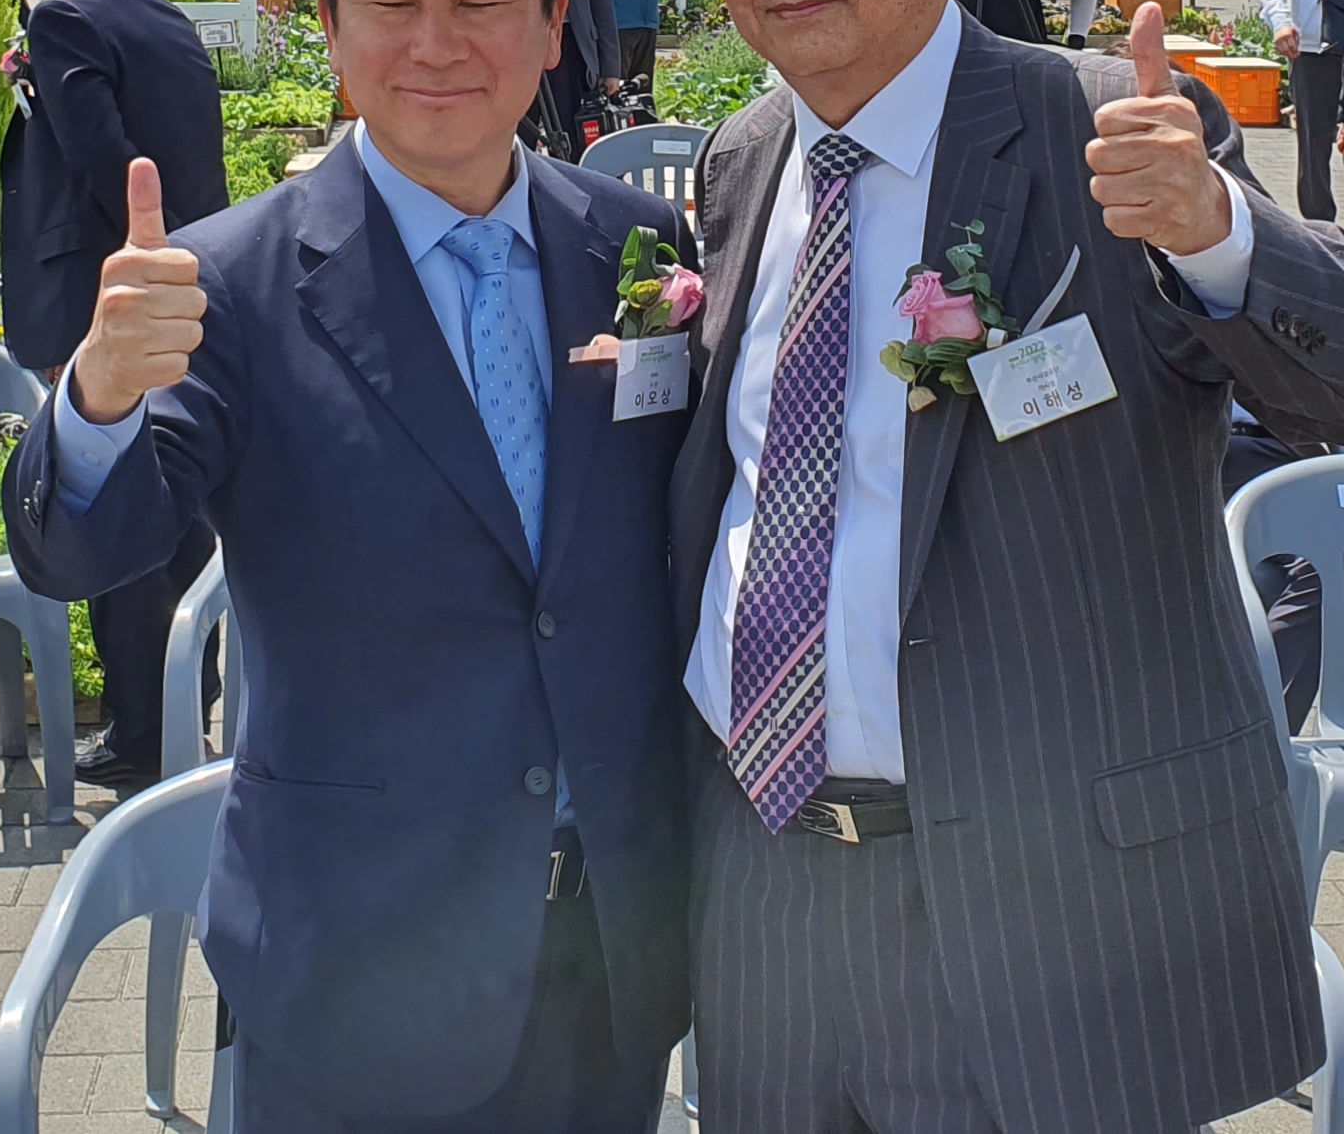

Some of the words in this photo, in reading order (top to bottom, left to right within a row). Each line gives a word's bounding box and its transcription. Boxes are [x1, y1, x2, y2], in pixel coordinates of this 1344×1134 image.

[1018, 340, 1046, 359] 2022
[634, 387, 671, 409] 이오상
[1022, 380, 1084, 416] 이해성
